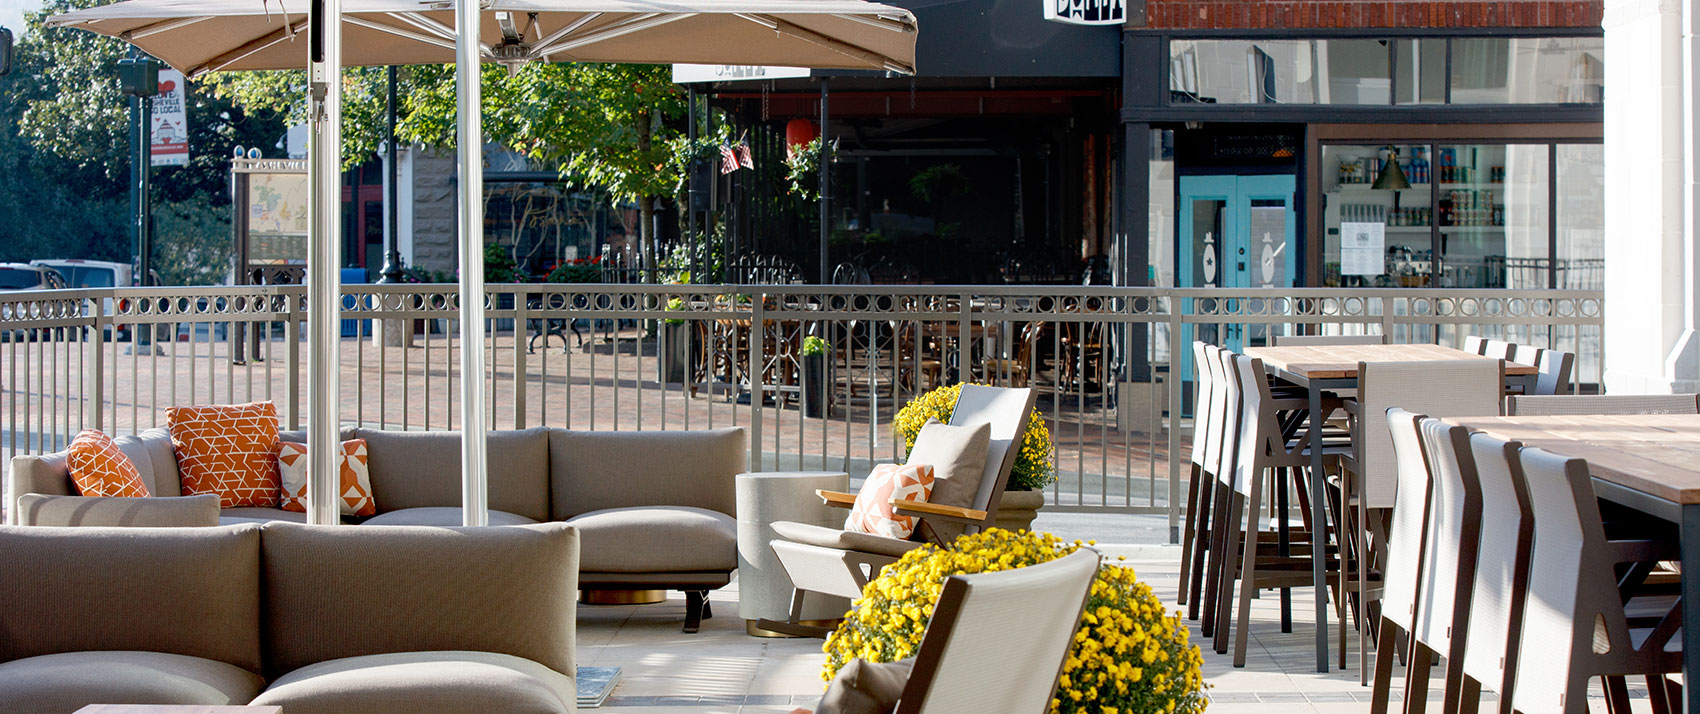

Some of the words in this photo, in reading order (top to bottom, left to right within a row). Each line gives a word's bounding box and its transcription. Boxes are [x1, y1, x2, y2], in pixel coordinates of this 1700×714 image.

[152, 98, 180, 106] SHEVILLE
[160, 105, 181, 114] LOCAL
[256, 161, 307, 170] ASHEVILL
